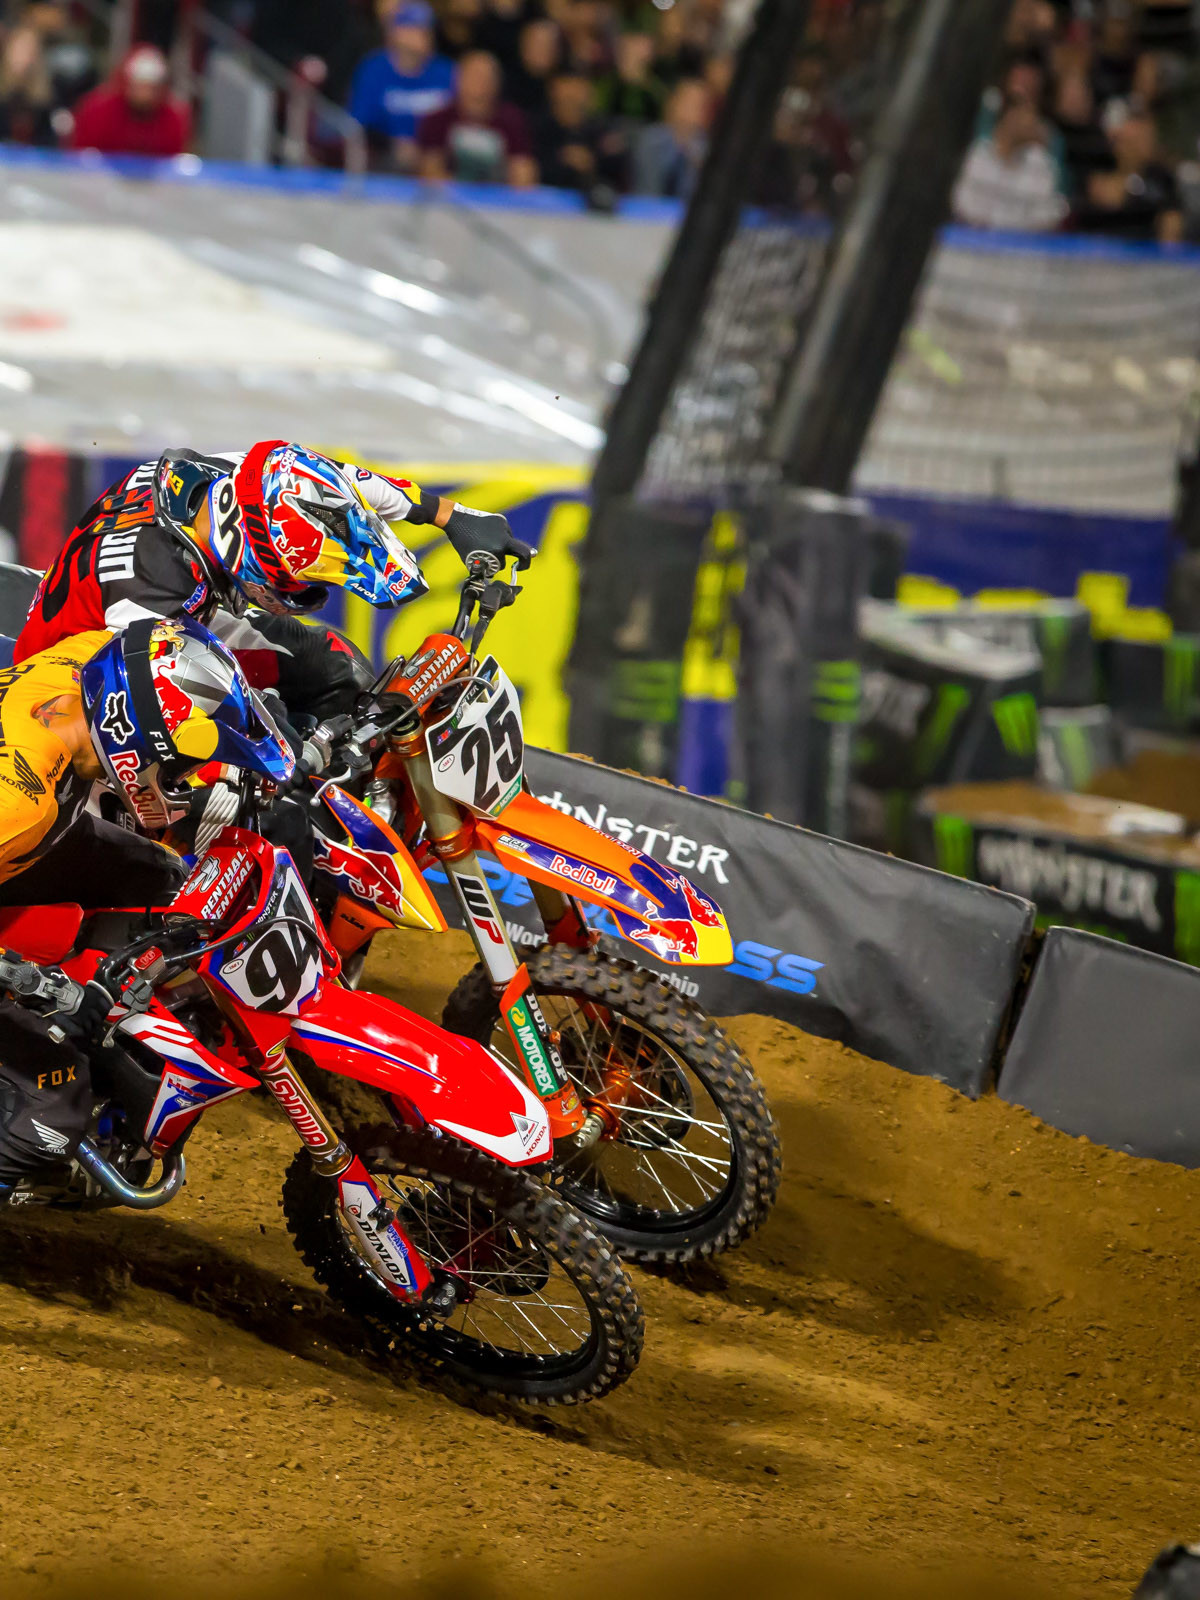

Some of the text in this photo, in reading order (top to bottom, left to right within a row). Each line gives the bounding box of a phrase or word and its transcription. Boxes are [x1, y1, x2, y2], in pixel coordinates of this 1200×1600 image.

[350, 581, 378, 601] Airoh
[390, 569, 412, 597] Red
[408, 642, 458, 698] RENTHAL
[148, 730, 177, 762] FOX
[460, 688, 524, 809] 25
[109, 750, 143, 795] Red
[200, 850, 247, 919] RENTHAL
[550, 854, 618, 896] Red Bull
[339, 912, 365, 931] KTM
[37, 1064, 77, 1090] FOX
[517, 1025, 555, 1094] MOTOREX
[267, 1078, 329, 1147] SHOWA
[525, 1125, 547, 1158] HONDA
[357, 1220, 408, 1286] DUNLOP
